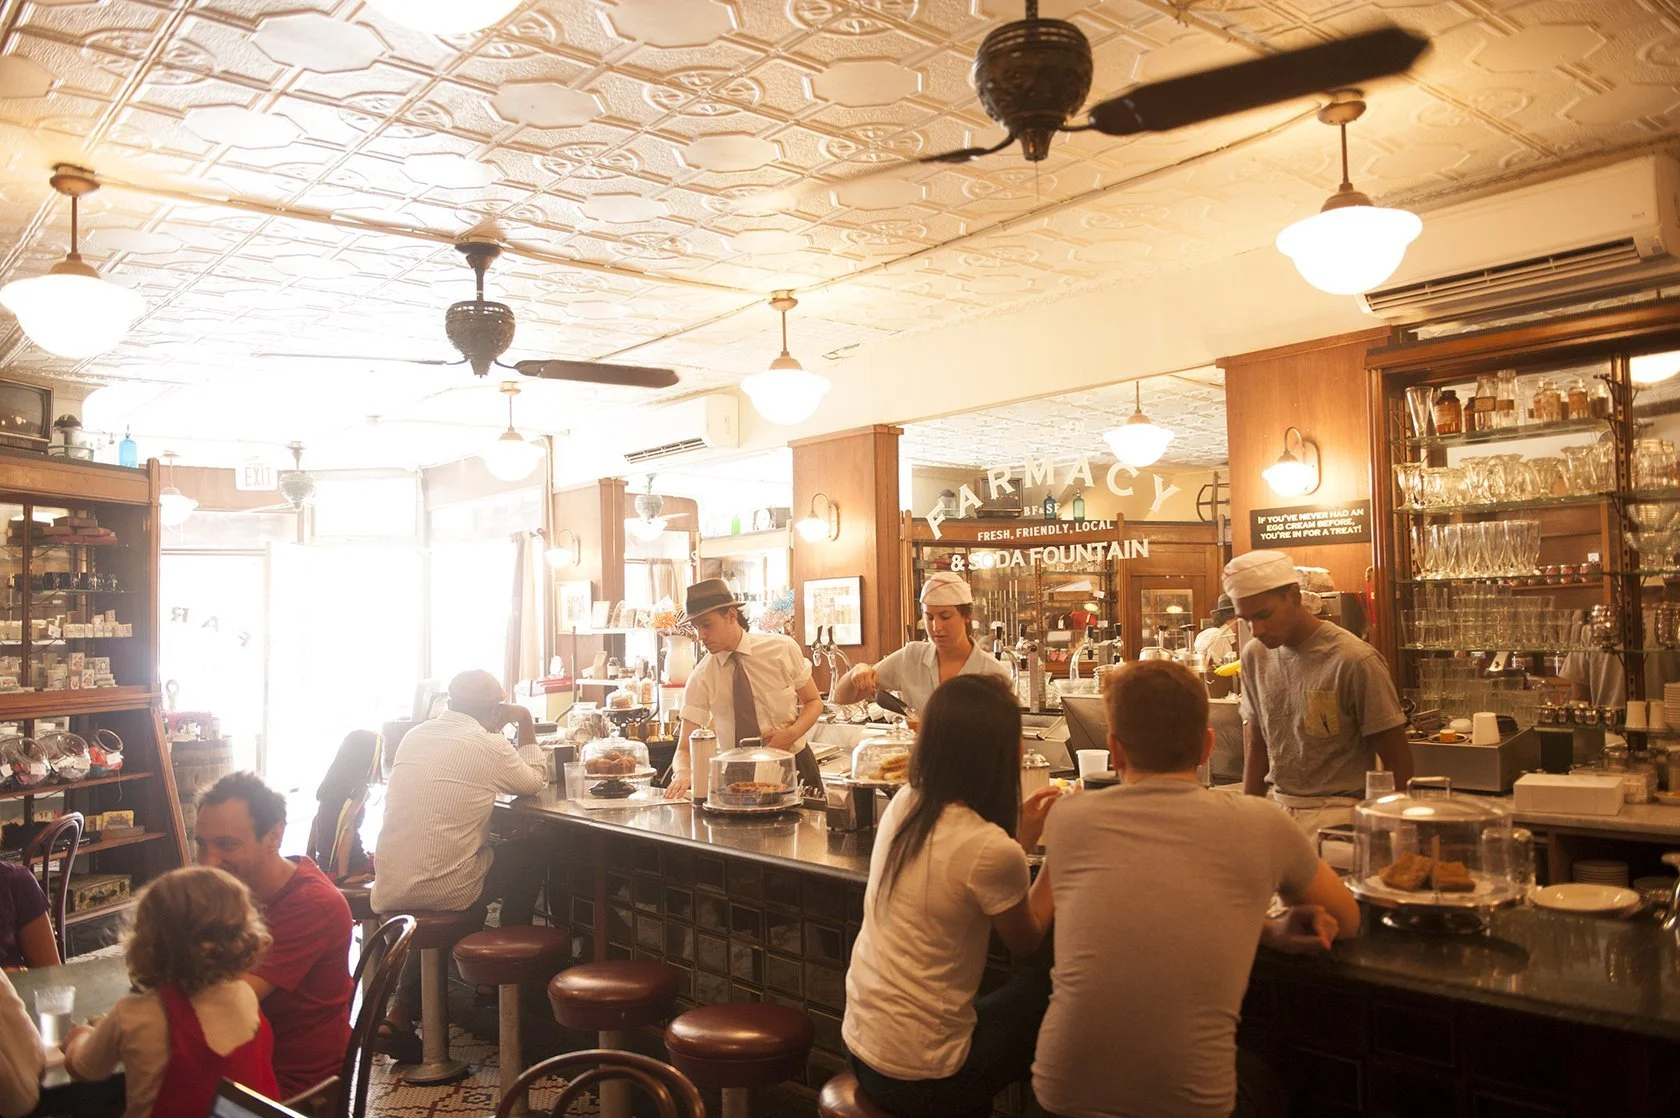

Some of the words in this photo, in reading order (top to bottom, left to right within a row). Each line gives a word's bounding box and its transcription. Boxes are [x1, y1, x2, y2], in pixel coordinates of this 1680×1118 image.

[245, 467, 271, 487] EXIT
[925, 455, 1181, 541] FARMACY
[1267, 514, 1298, 523] YOU'VE
[1299, 511, 1329, 521] NEVER
[1330, 510, 1350, 518] HAD
[1351, 508, 1364, 516] AN
[977, 531, 1014, 542] FRESH,
[1016, 523, 1073, 538] FRIENDLY,
[1075, 520, 1114, 533] LOCAL
[1260, 531, 1291, 540] YOU'RE
[1292, 530, 1302, 538] IN
[1303, 529, 1321, 537] FOR
[1322, 527, 1330, 535] A
[1330, 524, 1362, 535] TREAT!
[1266, 523, 1285, 531] EGG
[1285, 521, 1316, 530] CREAM
[951, 555, 965, 571] &
[968, 550, 1025, 571] SODA
[1029, 538, 1149, 566] FOUNTAIN
